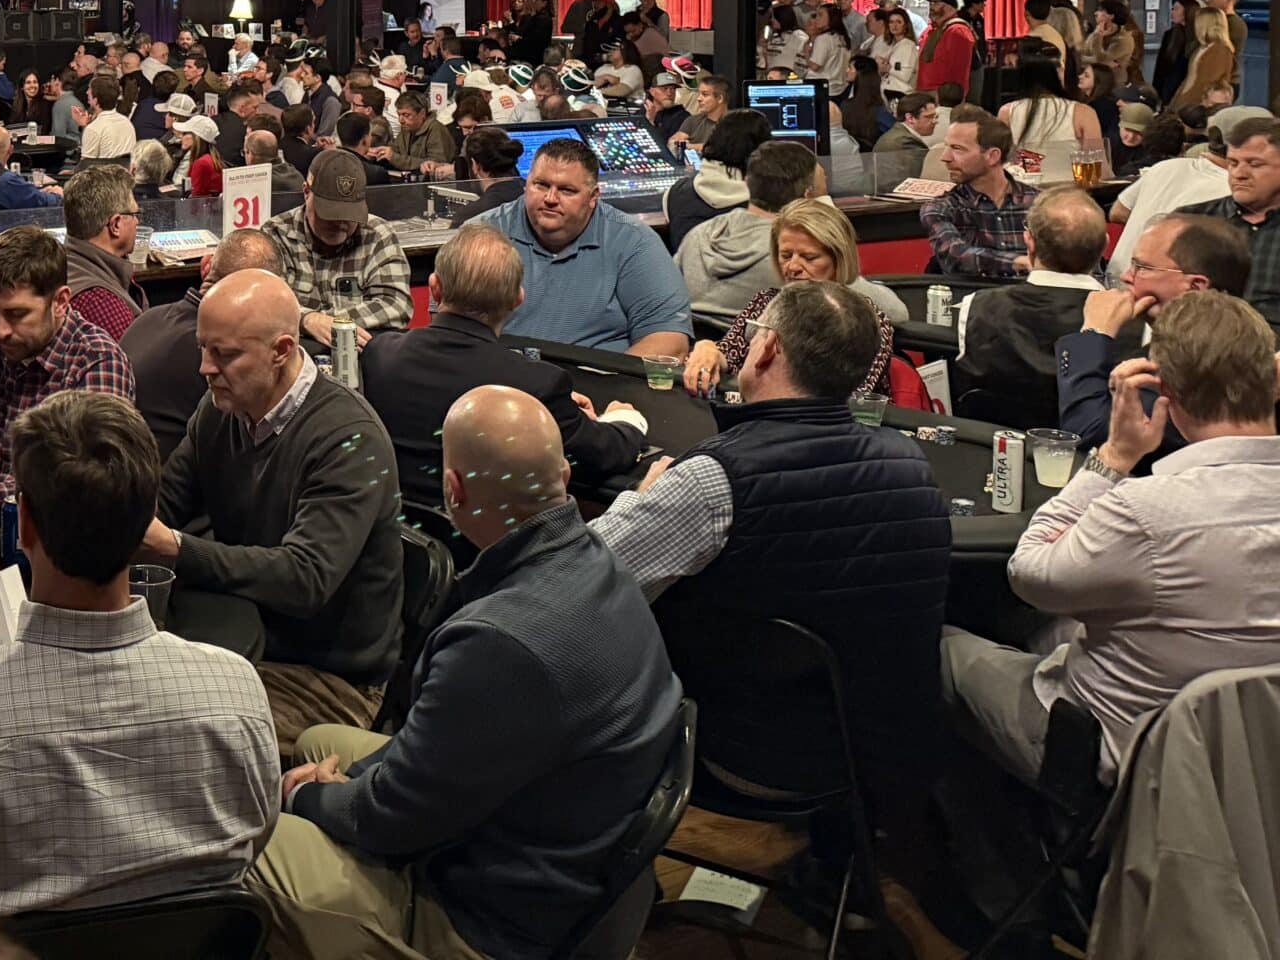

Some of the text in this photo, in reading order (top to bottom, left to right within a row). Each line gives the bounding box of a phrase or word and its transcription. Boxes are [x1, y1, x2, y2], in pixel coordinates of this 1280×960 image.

[435, 93, 443, 106] 9
[233, 195, 260, 228] 31
[997, 458, 1008, 499] ULTRA
